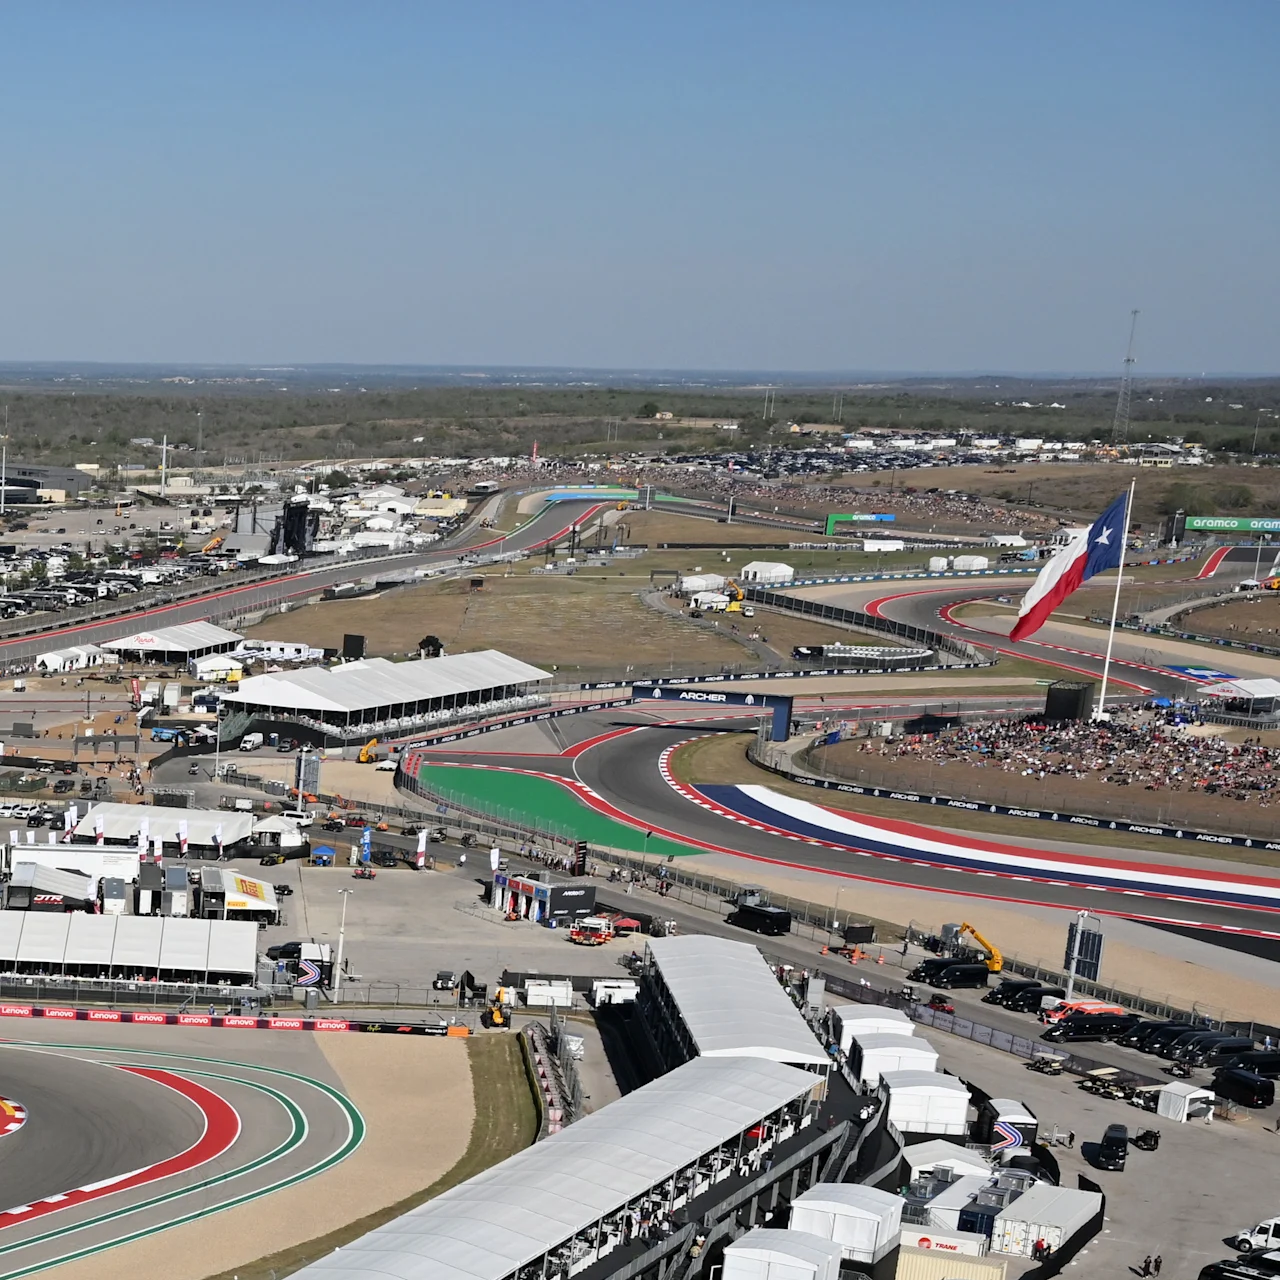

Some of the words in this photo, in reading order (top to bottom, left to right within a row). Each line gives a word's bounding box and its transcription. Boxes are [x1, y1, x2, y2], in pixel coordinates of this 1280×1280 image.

[680, 692, 726, 701] ARCHER
[837, 785, 863, 793] ARCHER
[890, 791, 919, 801] ARCHER
[948, 801, 978, 809] ARCHER
[1008, 809, 1039, 817] ARCHER
[1070, 817, 1098, 826] ARCHER
[1129, 826, 1162, 834] ARCHER
[1196, 833, 1232, 845] ARCHER
[226, 1018, 253, 1026] Lenovo
[317, 1021, 345, 1029] Lenovo
